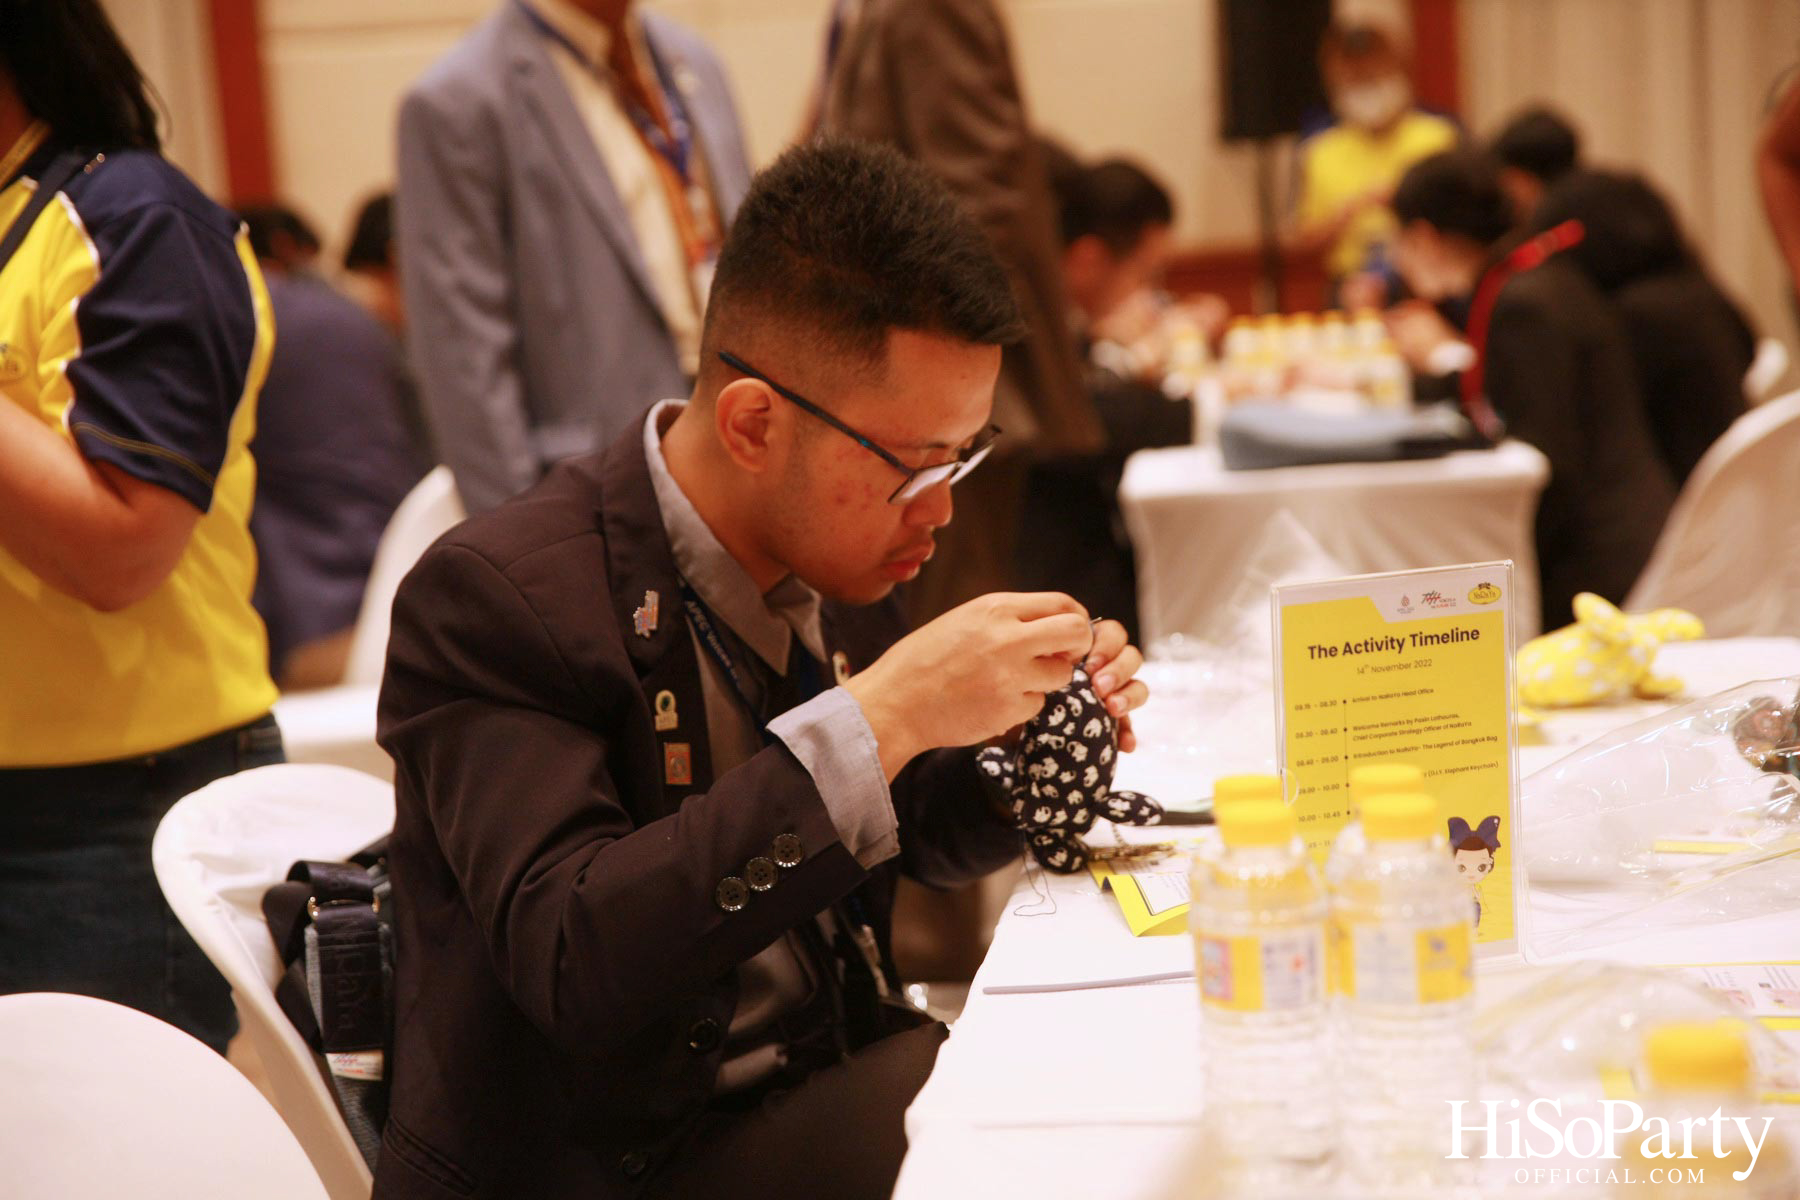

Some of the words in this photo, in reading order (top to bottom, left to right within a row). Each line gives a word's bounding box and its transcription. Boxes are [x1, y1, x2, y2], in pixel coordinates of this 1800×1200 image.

[1308, 643, 1338, 660] The
[1342, 634, 1405, 655] Activity
[1410, 627, 1480, 646] Timeline
[1371, 661, 1412, 674] November
[1414, 658, 1433, 669] 2022
[1369, 731, 1398, 739] Corporate
[1353, 750, 1389, 759] Introduction
[1433, 740, 1454, 749] Legend
[1461, 736, 1486, 744] Bangkok
[1445, 766, 1470, 774] Elephant
[1470, 761, 1499, 770] Keychain)
